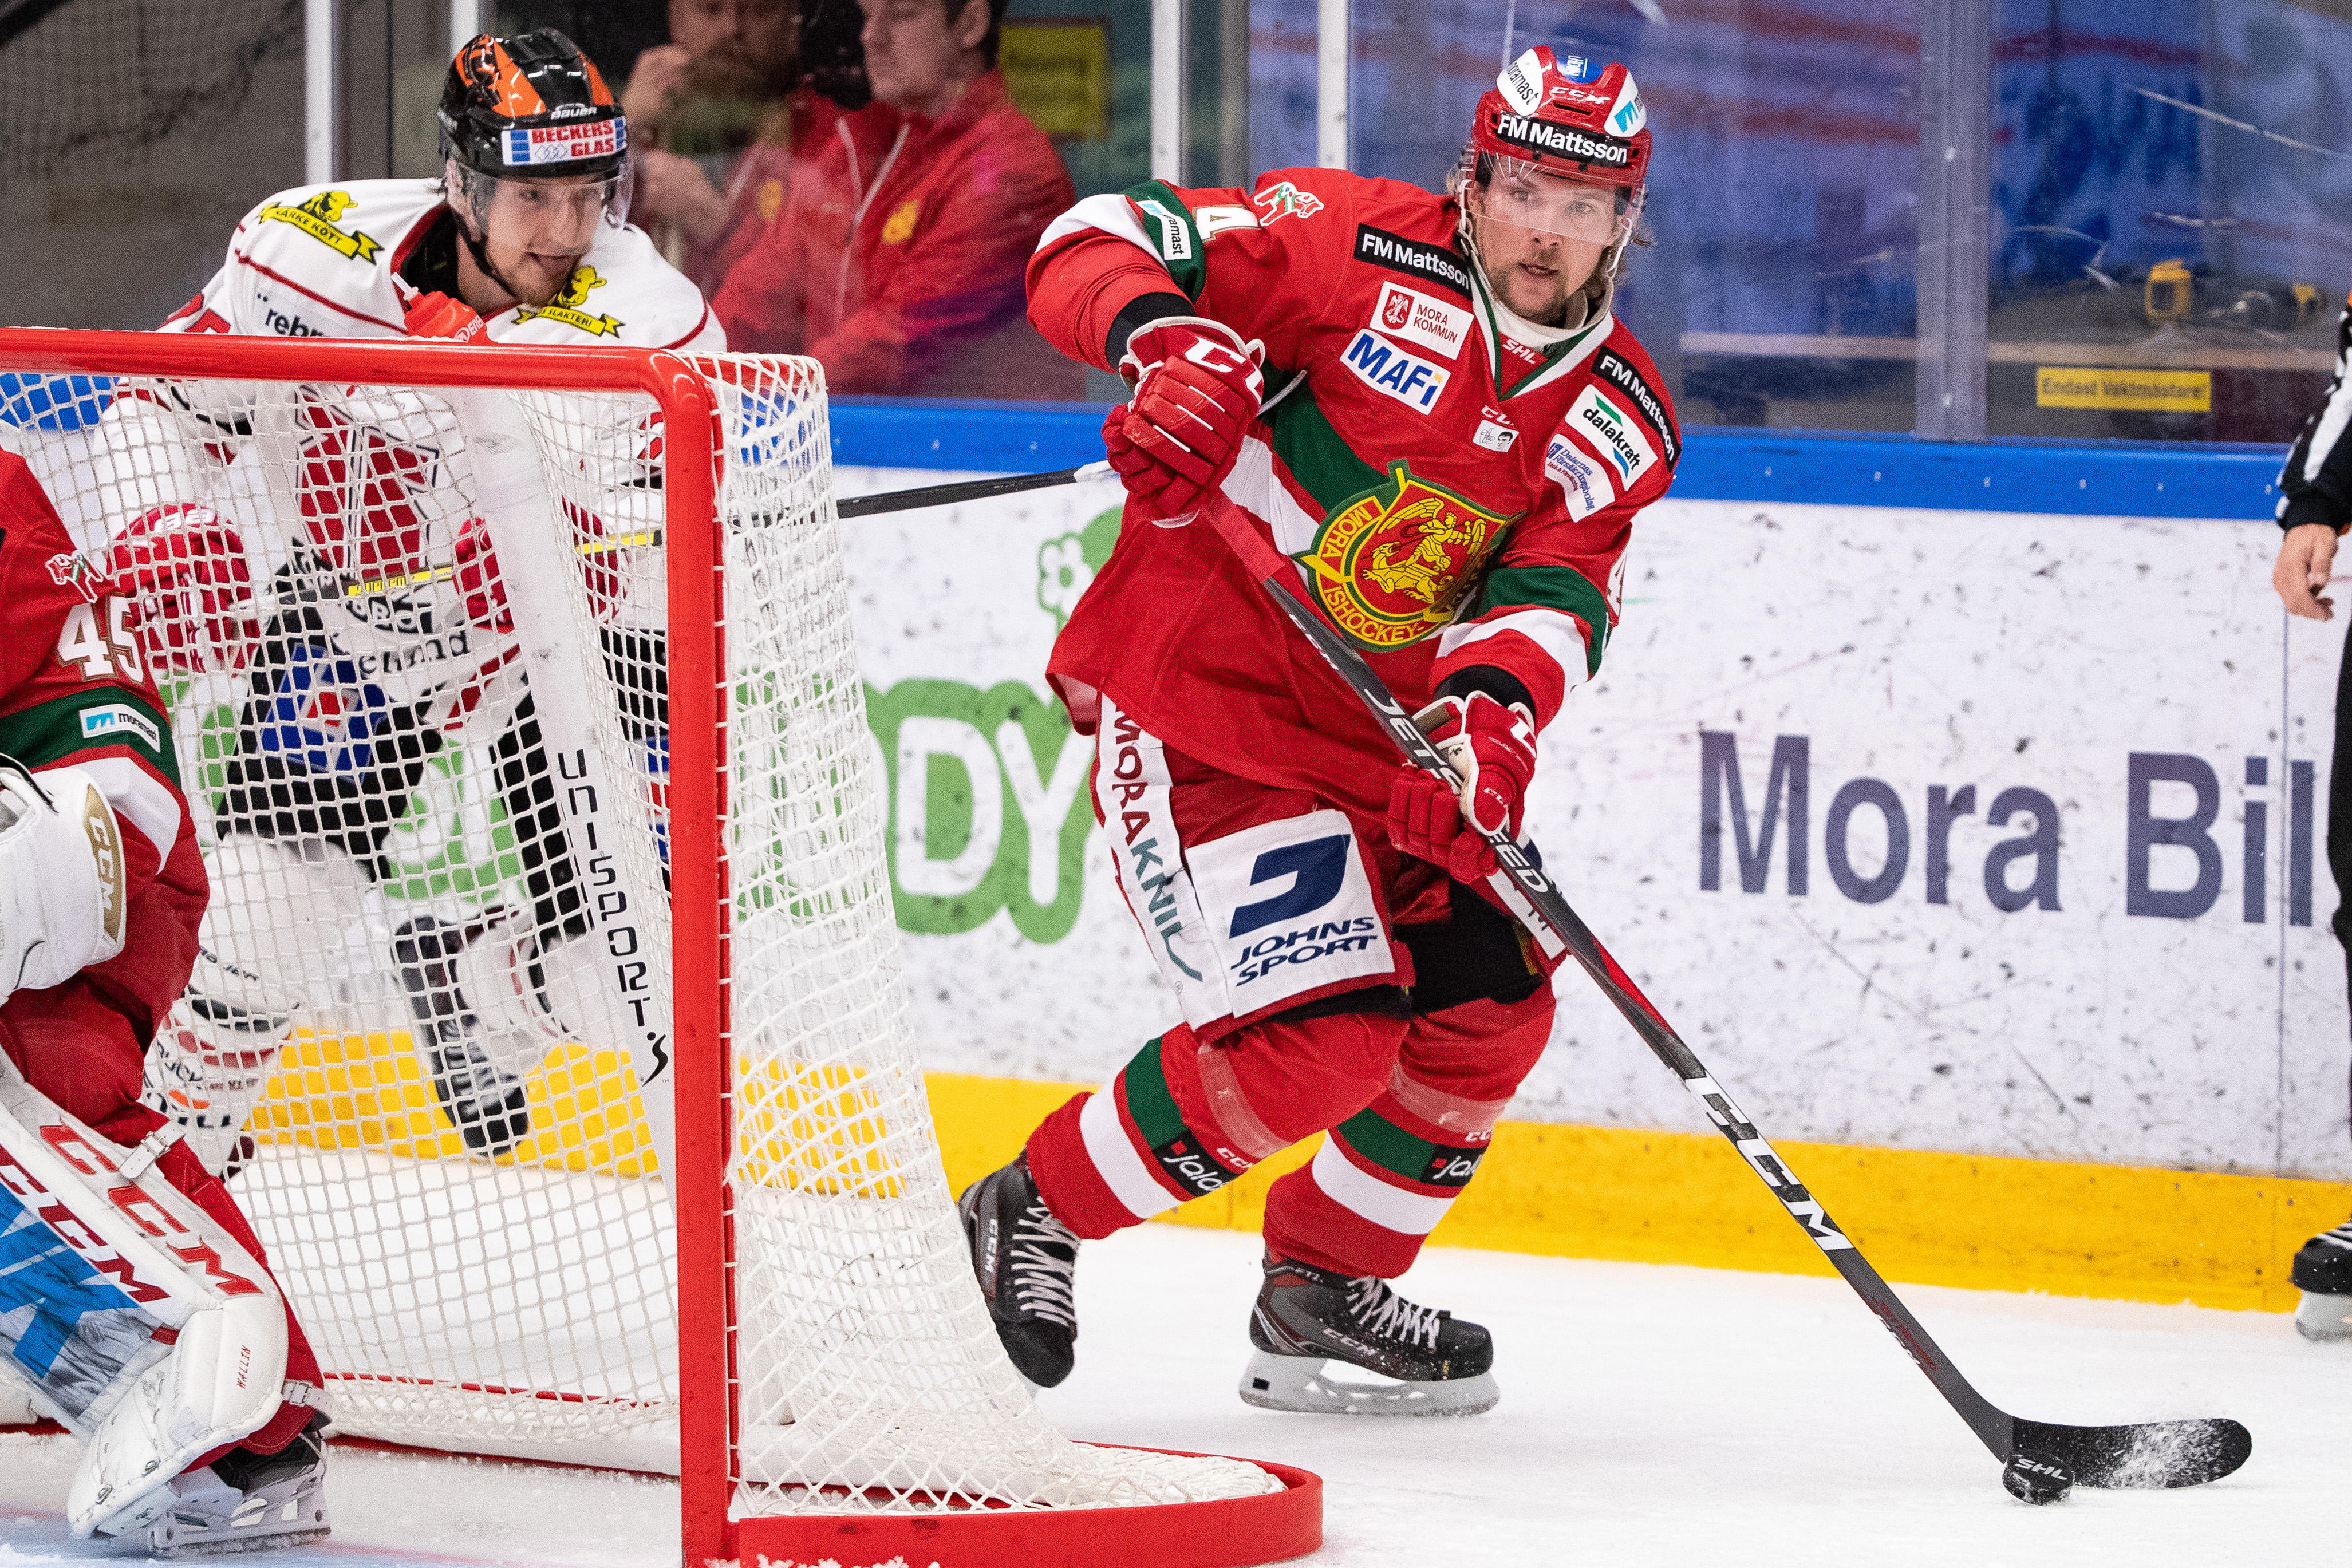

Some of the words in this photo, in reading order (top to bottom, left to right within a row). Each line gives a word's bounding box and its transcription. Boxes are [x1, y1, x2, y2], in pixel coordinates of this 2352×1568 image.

[531, 119, 614, 144] BECKERS
[550, 106, 598, 120] BAUER
[570, 137, 614, 157] GLAS
[1529, 123, 1627, 163] Mattsson
[1362, 233, 1394, 259] FM
[1395, 244, 1469, 290] Mattsson
[1413, 317, 1458, 343] KOMMUN
[1416, 304, 1449, 326] MORA
[1502, 339, 1536, 365] SHL
[1600, 354, 1633, 386] FM
[1630, 377, 1675, 461] Mattsson
[1582, 408, 1640, 471] dalakraft
[1322, 504, 1374, 559] MORA
[56, 593, 145, 685] 45
[1698, 730, 2063, 913] Mora
[2125, 751, 2314, 927] Bil
[1230, 917, 1375, 970] JOHNS
[1236, 935, 1378, 987] SPORT
[1685, 1068, 1855, 1251] CCM
[39, 1114, 265, 1296] CCM
[236, 1345, 252, 1390] WALLIN
[2014, 1458, 2068, 1480] SHL
